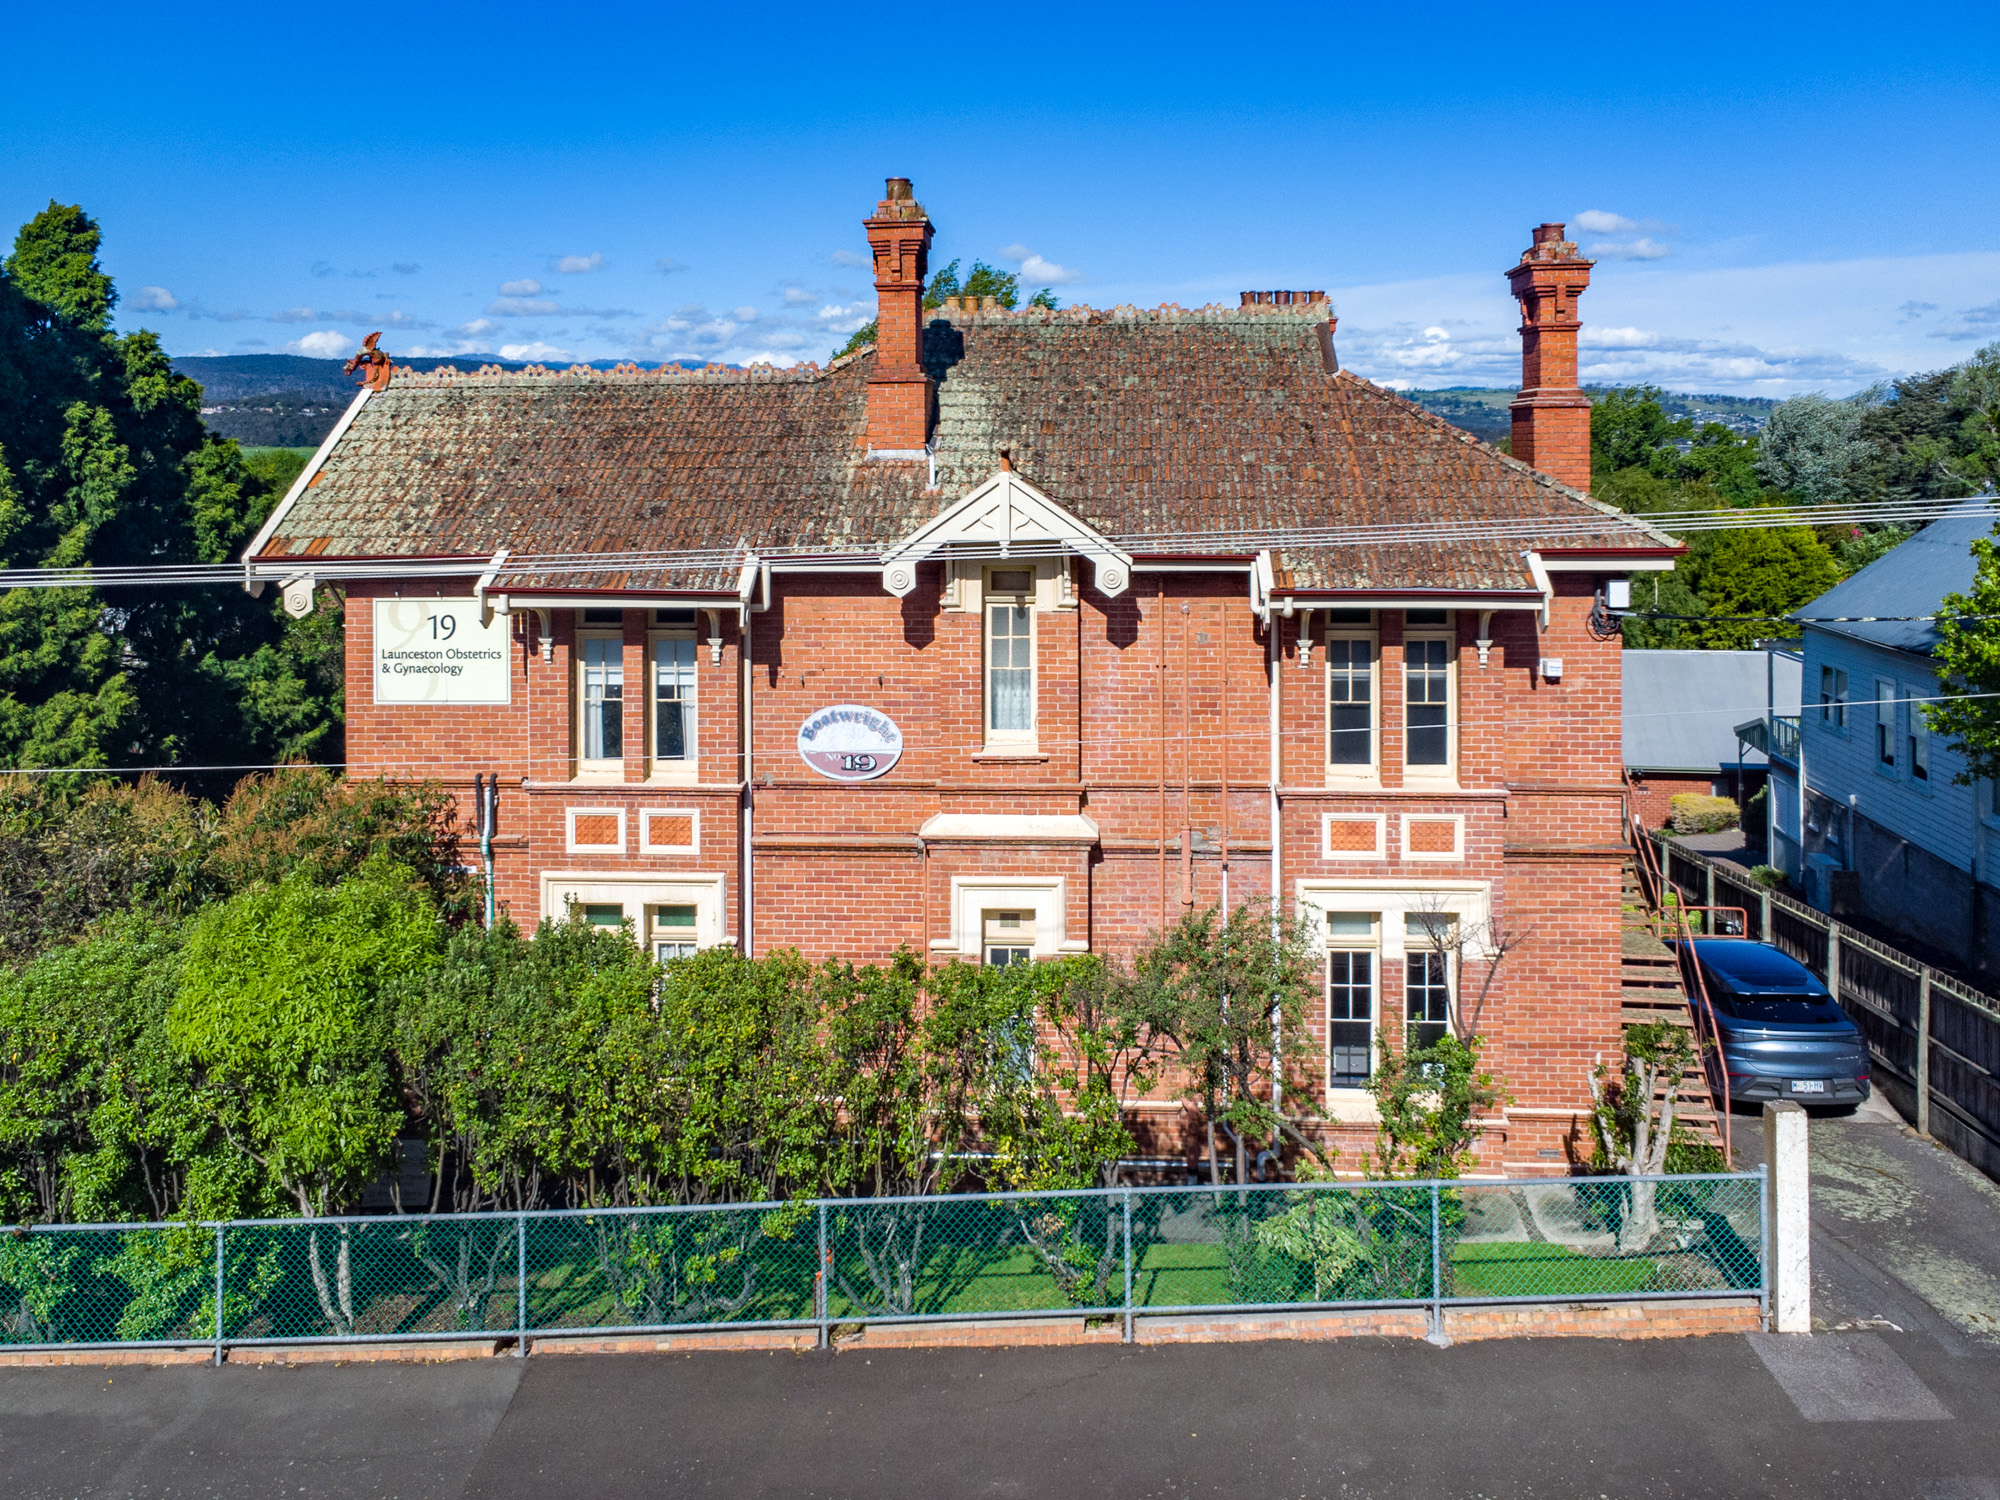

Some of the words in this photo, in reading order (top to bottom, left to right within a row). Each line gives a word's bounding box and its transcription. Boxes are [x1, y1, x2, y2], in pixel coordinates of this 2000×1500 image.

[427, 614, 456, 641] 19
[381, 648, 442, 660] Launceston
[445, 648, 502, 660] Obstetrics
[381, 663, 391, 674] &
[393, 662, 464, 677] Gynaecology
[801, 710, 897, 743] Boatwright
[841, 754, 877, 772] 19
